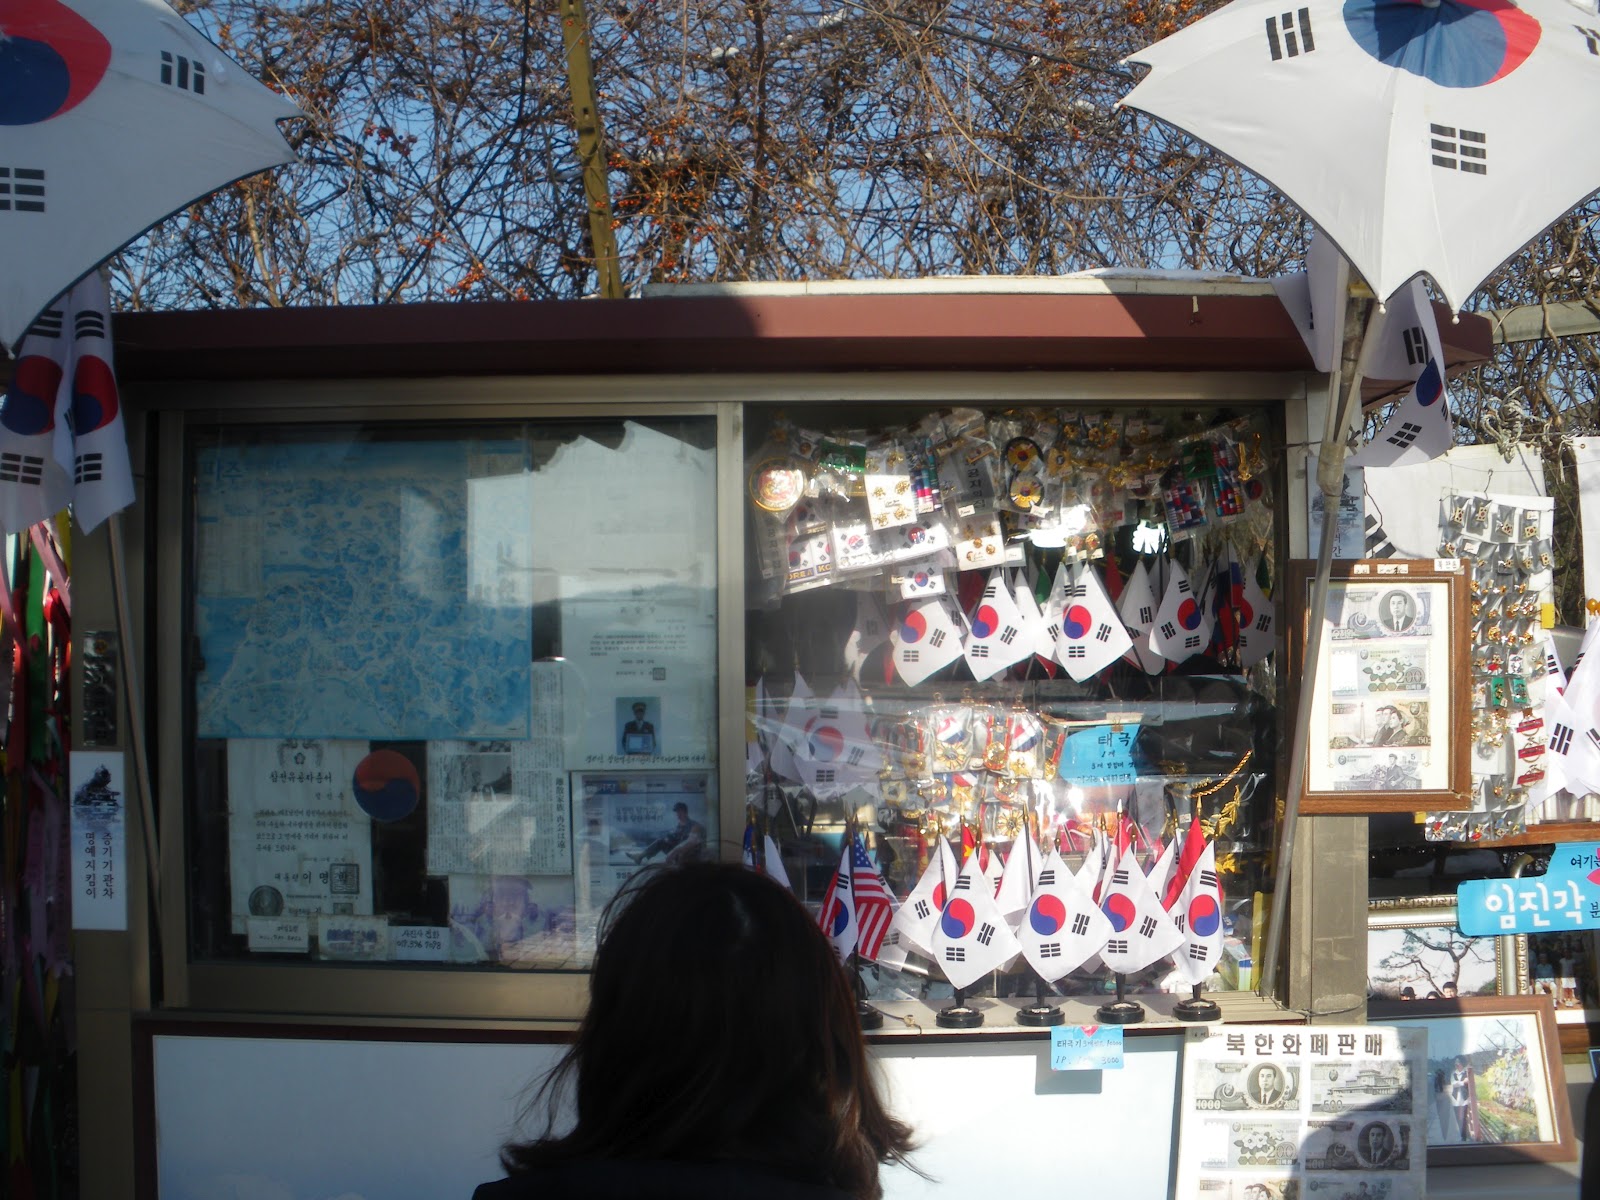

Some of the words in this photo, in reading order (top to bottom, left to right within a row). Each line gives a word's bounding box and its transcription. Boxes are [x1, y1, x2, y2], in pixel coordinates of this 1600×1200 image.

[1396, 671, 1424, 683] 200
[85, 832, 97, 901] 명예지킴이
[102, 832, 114, 901] 증기기관차
[1485, 879, 1586, 929] 임진각
[1267, 1144, 1297, 1158] 200
